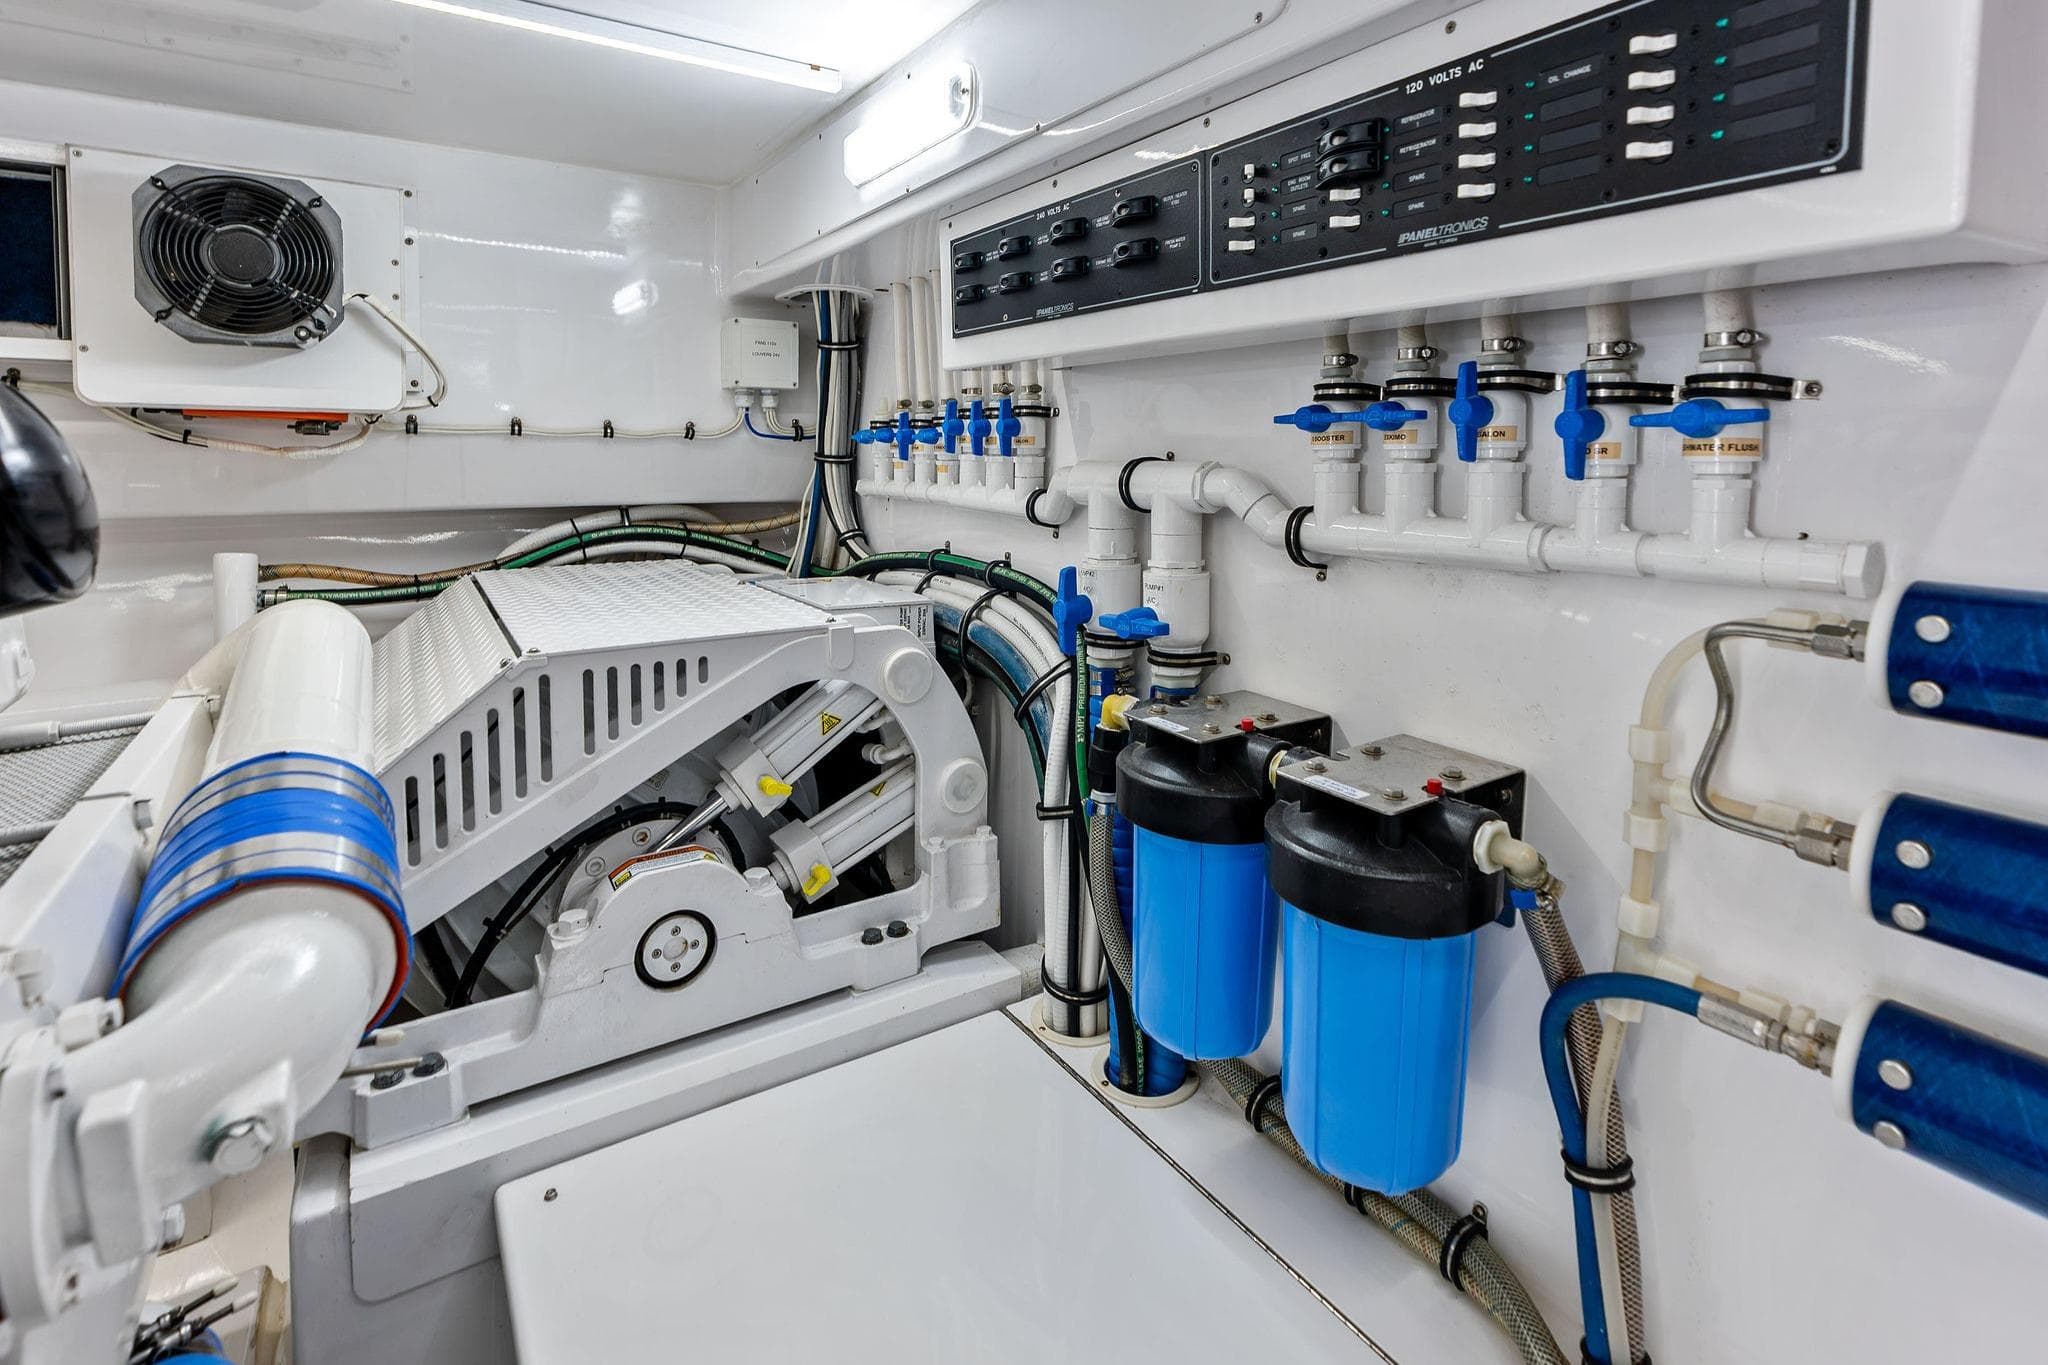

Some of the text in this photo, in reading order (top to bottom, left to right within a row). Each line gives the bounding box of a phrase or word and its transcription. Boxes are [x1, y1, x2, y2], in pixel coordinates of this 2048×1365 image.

[1406, 58, 1484, 95] 120 VOLTS AC
[1548, 64, 1592, 84] OIL CHANGE
[1401, 108, 1435, 124] REFRIGERATOR
[1400, 138, 1437, 154] REFRIGERATOR
[1409, 172, 1426, 182] SPARE
[1036, 213, 1045, 221] 240
[1048, 206, 1061, 217] VOLTS
[1292, 204, 1306, 213] SPARE
[1408, 202, 1425, 211] SPARE
[1292, 230, 1306, 238] SPARE
[1399, 216, 1489, 244] PANELTRONICS
[1078, 645, 1086, 673] MARINE
[1078, 674, 1086, 710] PREMIUM
